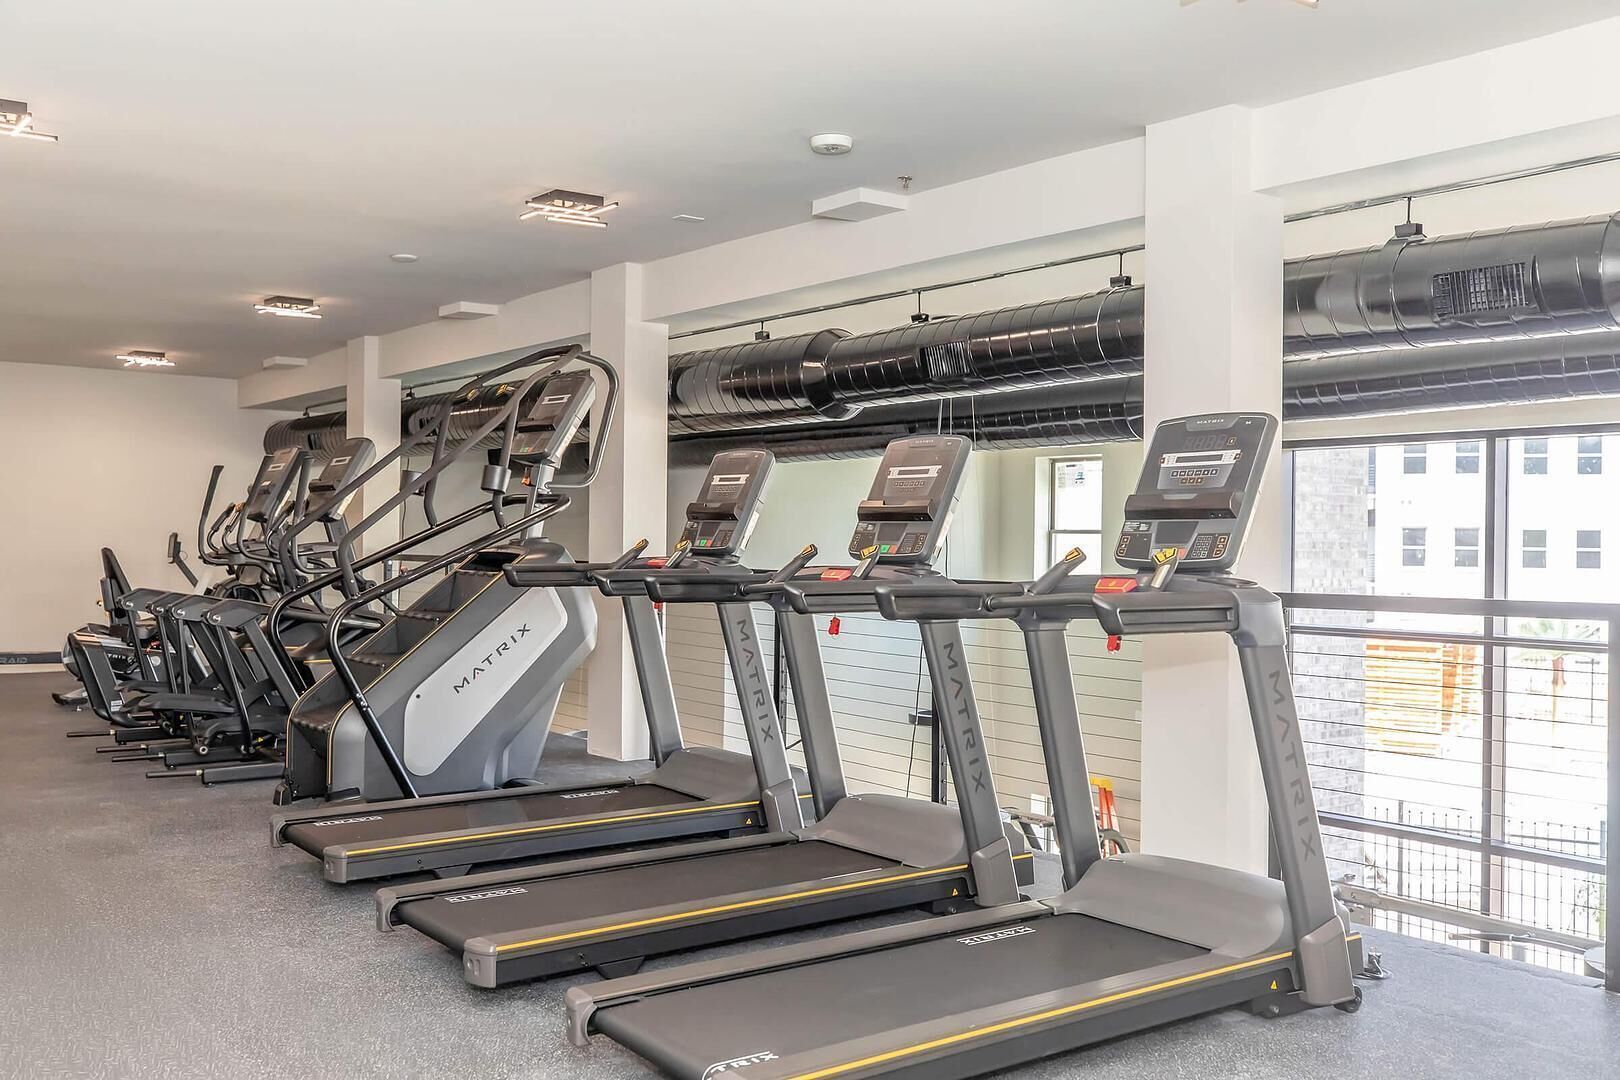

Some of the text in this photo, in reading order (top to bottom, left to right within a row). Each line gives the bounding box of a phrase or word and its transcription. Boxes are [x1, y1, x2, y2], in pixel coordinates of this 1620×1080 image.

[453, 623, 531, 694] MATRIX
[737, 618, 774, 743] MATRIX
[943, 641, 986, 793] MATRIX
[1269, 669, 1317, 862] MATRIX
[706, 1053, 779, 1080] TRIX
